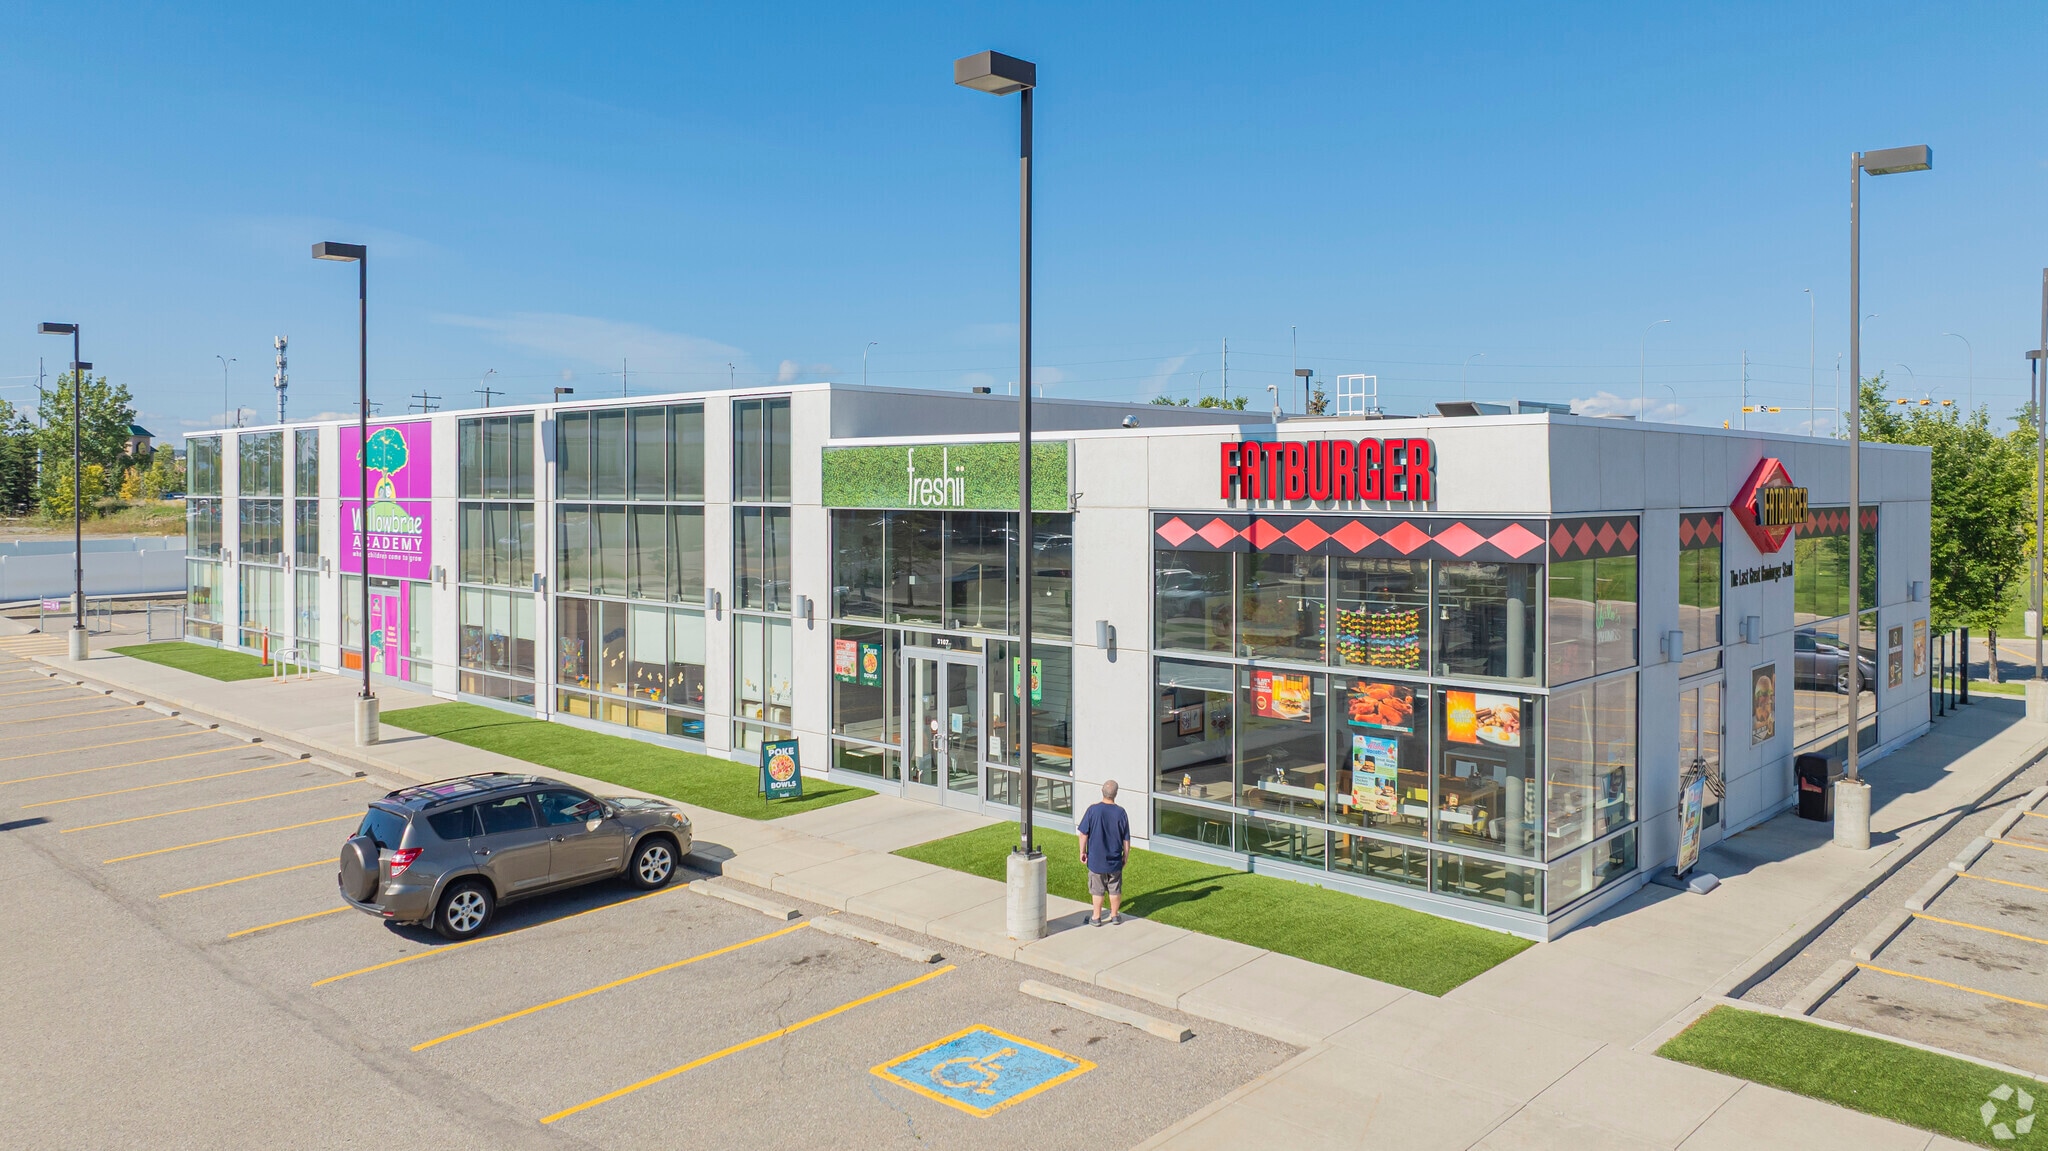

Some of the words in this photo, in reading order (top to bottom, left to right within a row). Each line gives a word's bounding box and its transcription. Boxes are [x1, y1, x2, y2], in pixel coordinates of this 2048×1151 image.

[907, 447, 965, 506] freshii
[1220, 437, 1435, 502] FATBURGER
[352, 507, 423, 534] Wllowbrae
[1764, 487, 1808, 525] FATBURGER
[1730, 569, 1738, 588] The
[1738, 568, 1749, 586] Last
[768, 747, 794, 757] POKE
